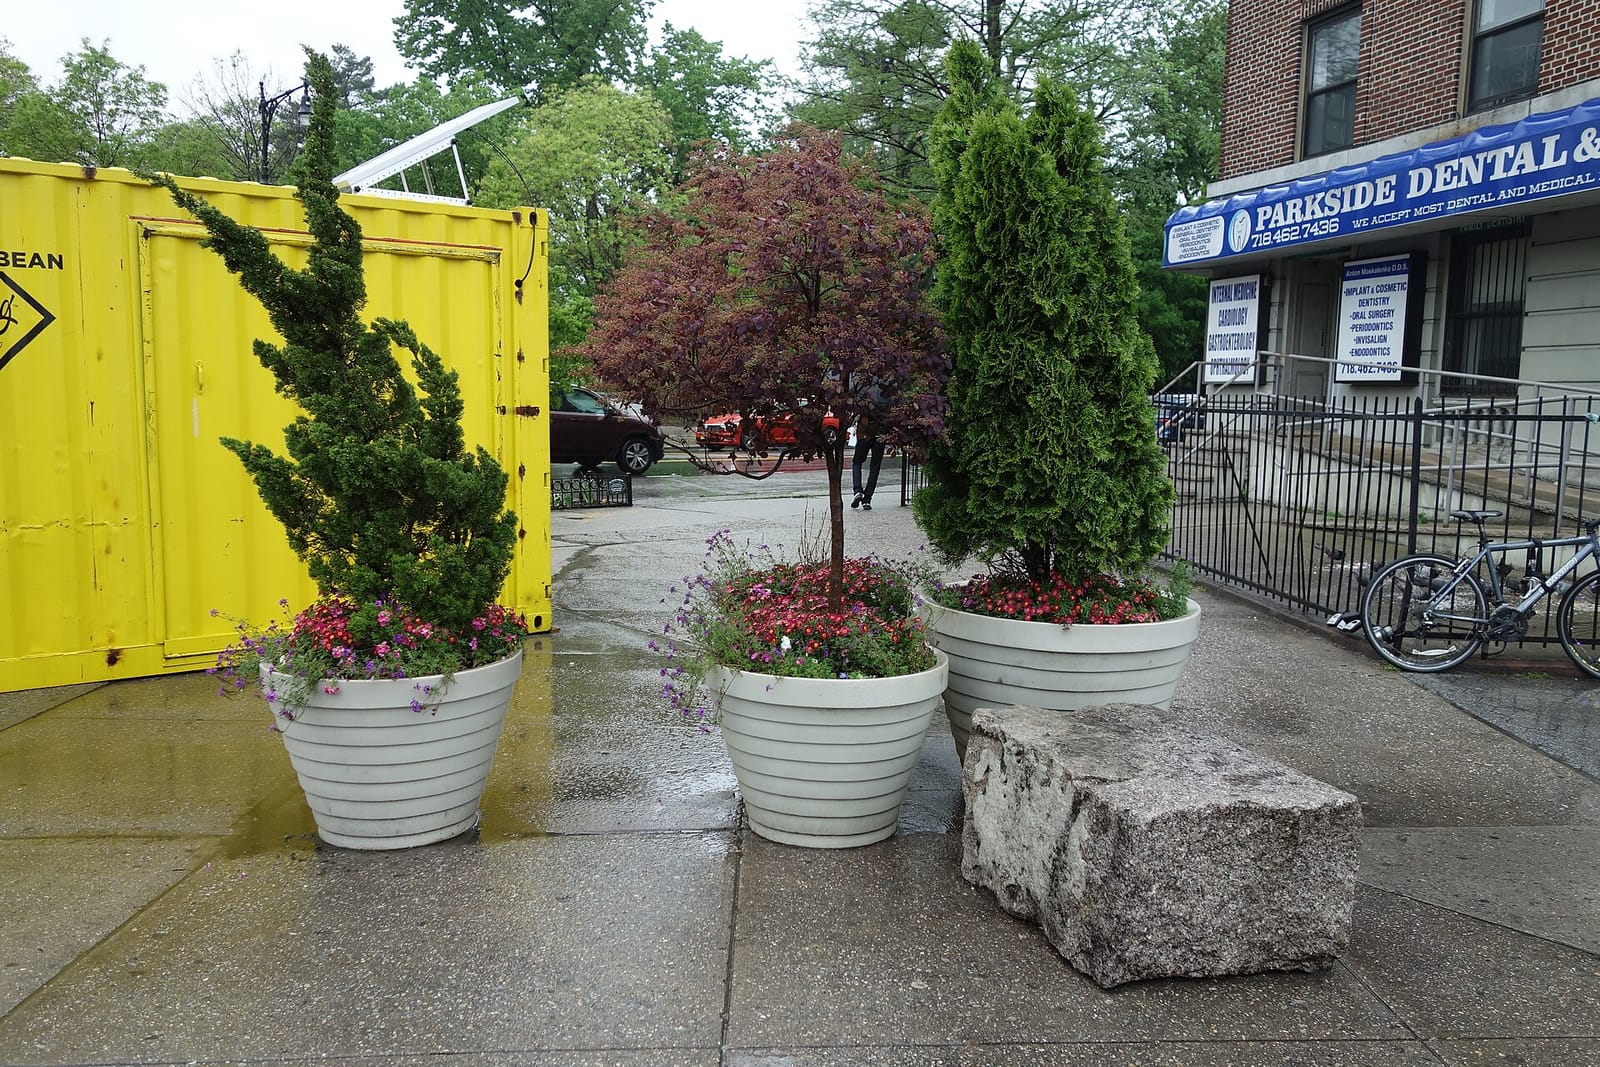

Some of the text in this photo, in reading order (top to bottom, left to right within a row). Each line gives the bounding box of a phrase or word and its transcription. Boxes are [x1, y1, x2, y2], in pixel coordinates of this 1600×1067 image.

[1255, 127, 1600, 231] PARKSIDE DENTAL &
[1352, 219, 1369, 228] WE
[1371, 209, 1412, 225] ACCEPT
[1414, 203, 1444, 217] MOST
[1446, 191, 1496, 210] DENTAL
[1498, 186, 1527, 200] AND
[1528, 173, 1596, 195] MEDICAL
[1251, 218, 1340, 248] 718.462.7436
[1211, 281, 1257, 304] INTERNAL MEDICINE
[1375, 281, 1407, 294] COSMETIC
[1358, 296, 1390, 308] DENTISTRY
[1218, 306, 1249, 328] CARDIOLOGY
[1352, 309, 1395, 320] ORAL SURGERY
[1352, 321, 1393, 333] PERIODONTICS
[1208, 332, 1256, 352] GASTROENTEROLOGY
[1351, 347, 1391, 357] ENDODONTICS
